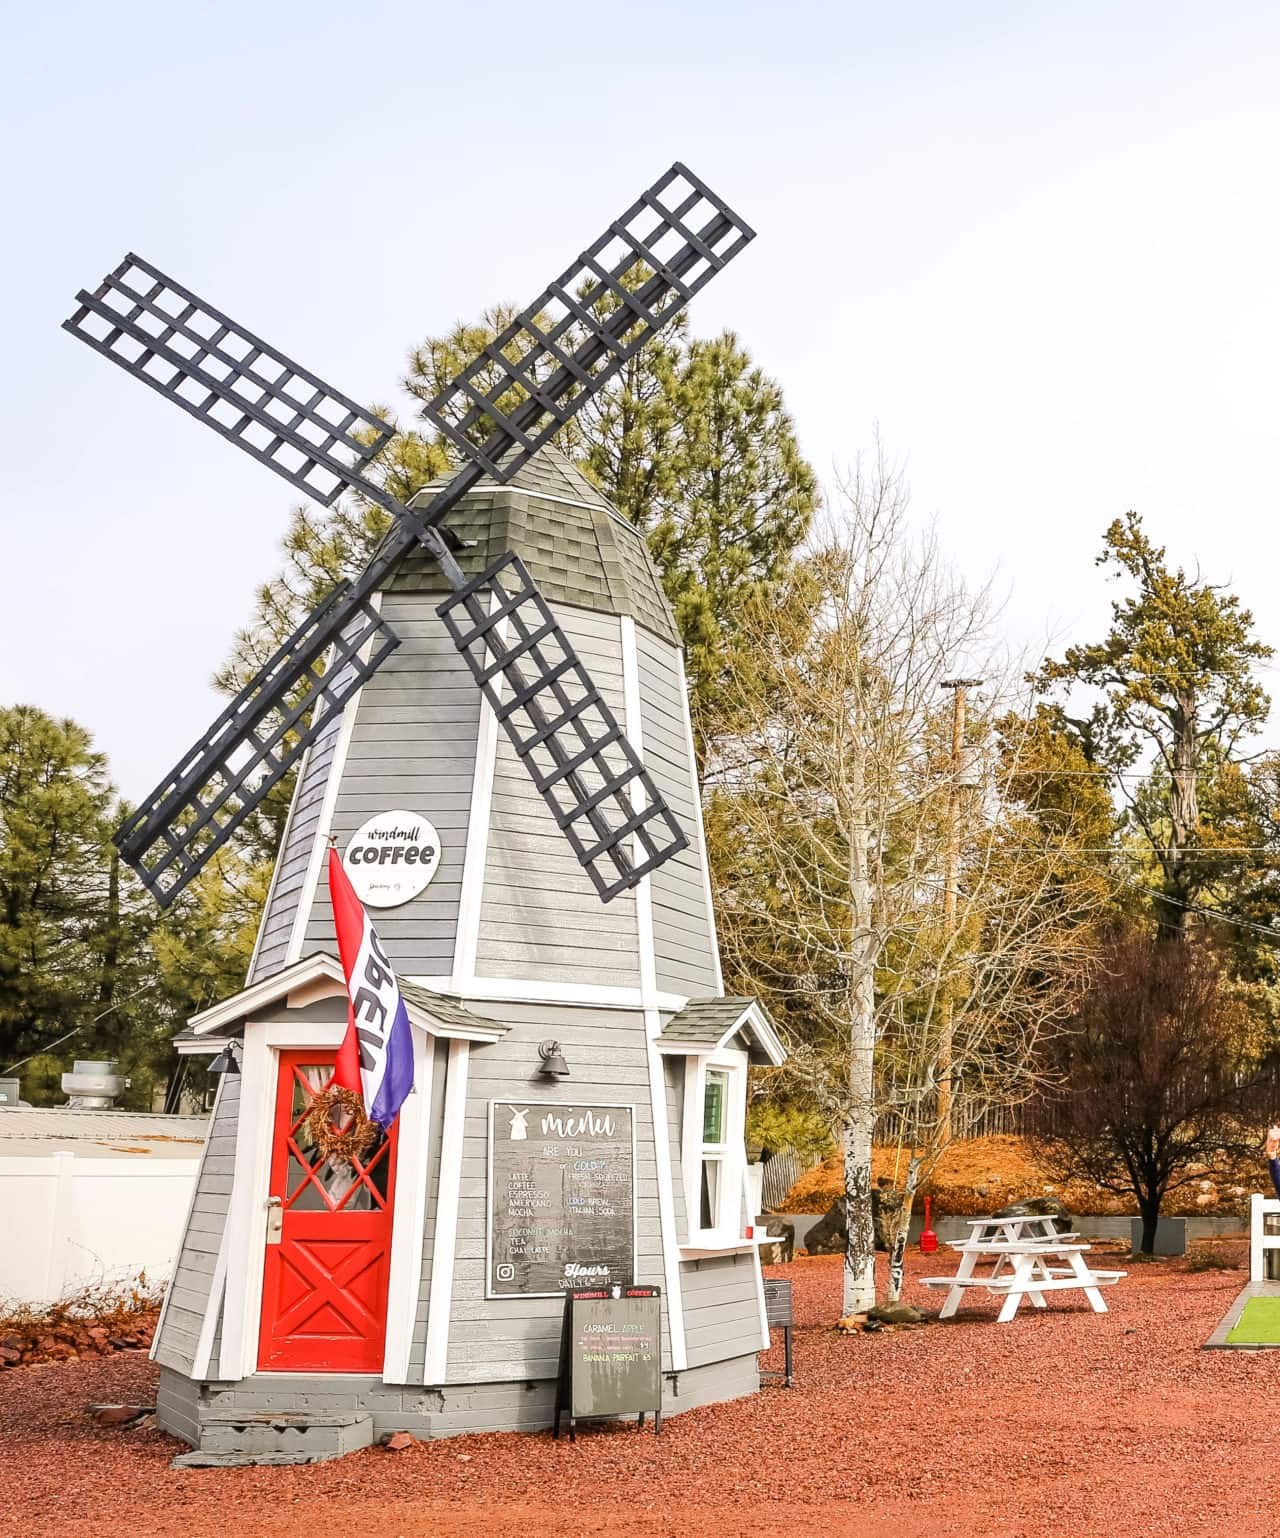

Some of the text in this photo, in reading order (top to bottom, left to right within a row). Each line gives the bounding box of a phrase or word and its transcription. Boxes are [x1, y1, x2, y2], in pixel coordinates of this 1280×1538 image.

[367, 826, 421, 842] windmill
[541, 1110, 616, 1138] menu
[511, 1237, 526, 1245] TEA
[564, 1263, 610, 1278] Hours
[583, 1322, 616, 1333] CARAMEL
[582, 1352, 610, 1362] BANANA
